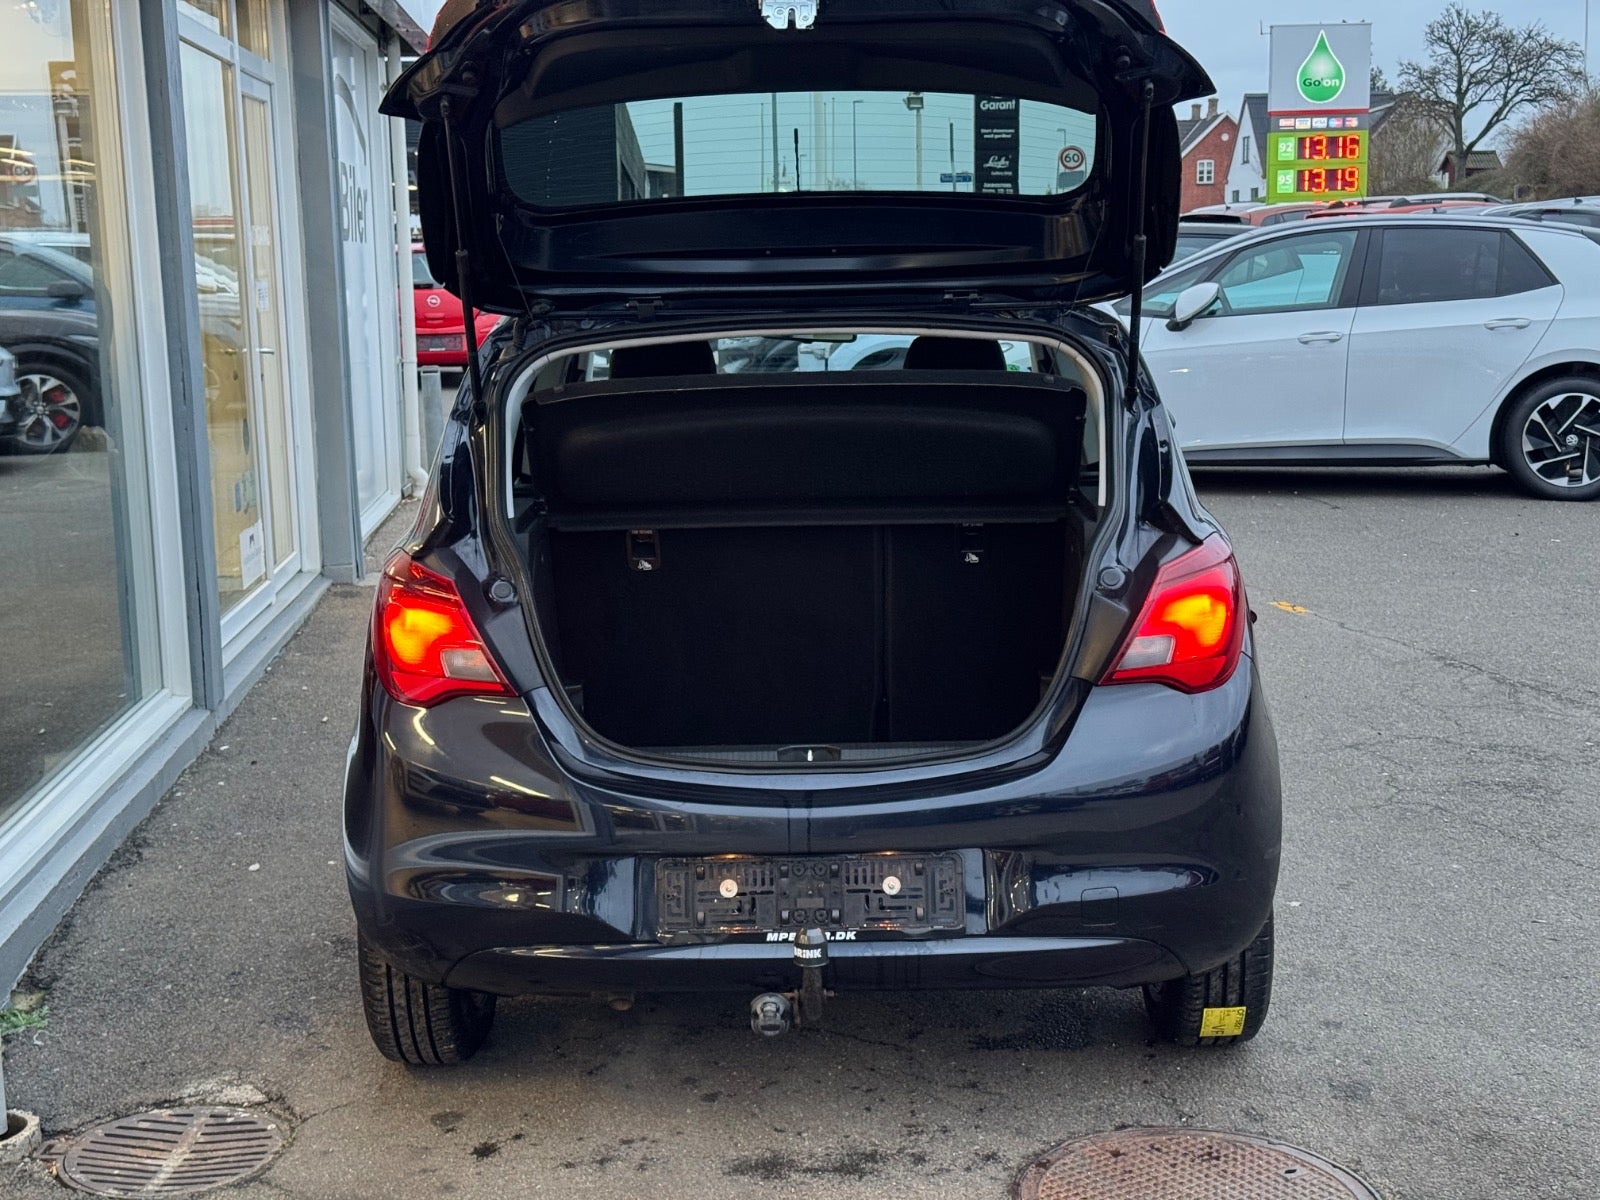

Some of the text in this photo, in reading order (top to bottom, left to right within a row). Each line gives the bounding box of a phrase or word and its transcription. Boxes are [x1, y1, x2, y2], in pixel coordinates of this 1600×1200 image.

[1302, 77, 1340, 88] Go'on
[980, 99, 1016, 111] Garant
[1279, 134, 1360, 160] 92 13.16
[1064, 153, 1080, 163] 60
[1278, 167, 1360, 193] 95 13.19
[340, 161, 368, 244] Biler
